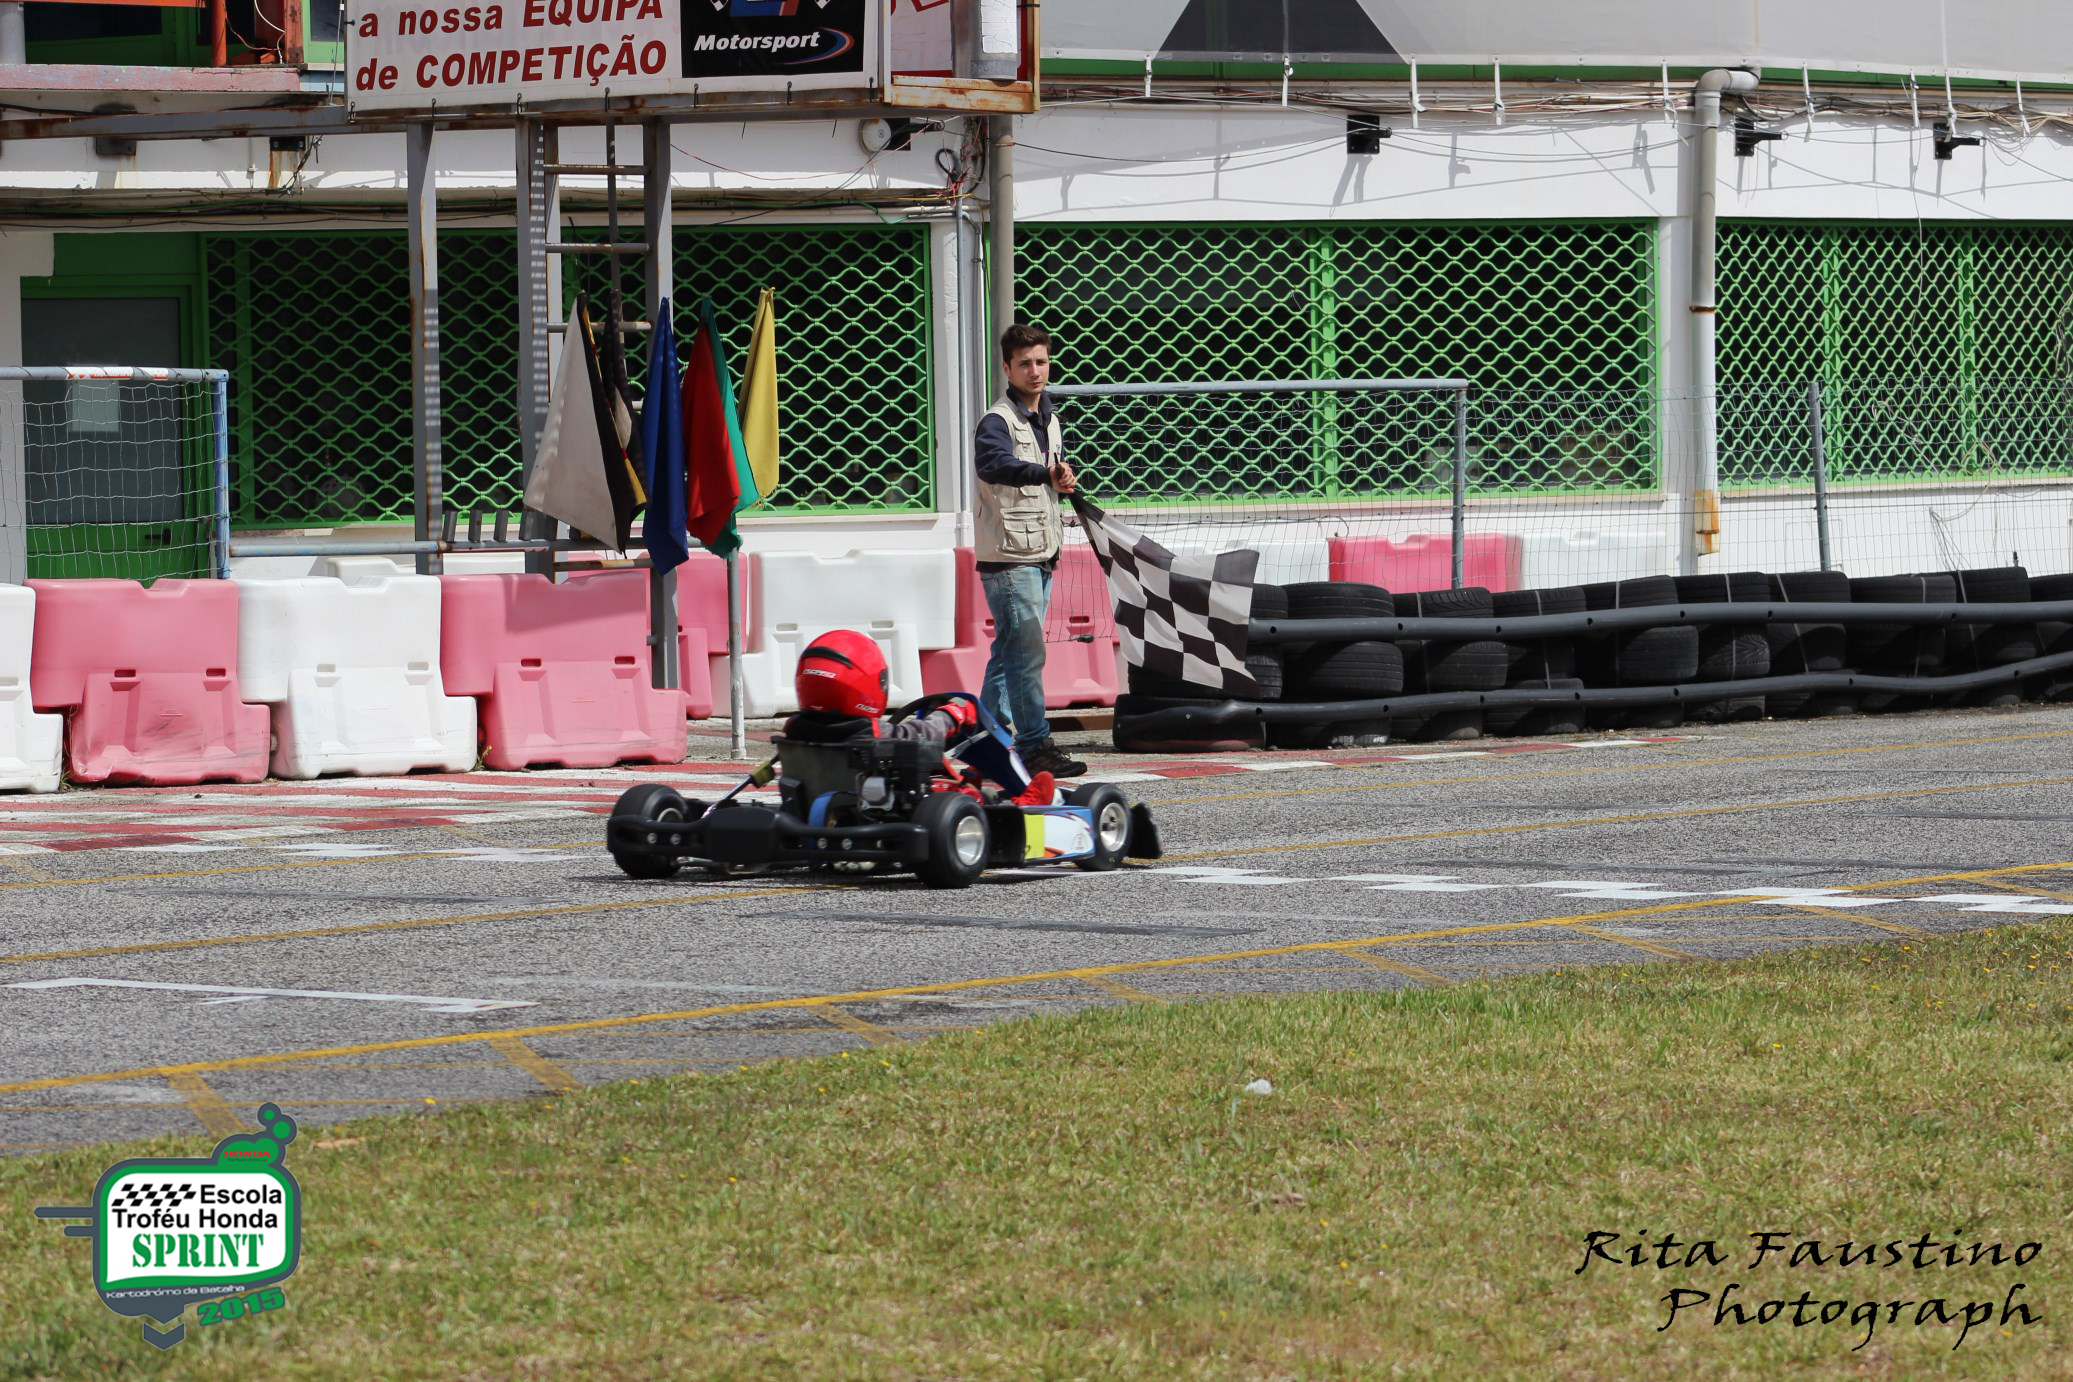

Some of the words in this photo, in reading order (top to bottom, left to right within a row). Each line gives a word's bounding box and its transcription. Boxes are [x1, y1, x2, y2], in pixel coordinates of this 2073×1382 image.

[358, 12, 379, 38] a
[398, 5, 503, 36] nossa
[522, 0, 663, 28] EQUIPA
[693, 31, 821, 53] Motorsport
[355, 58, 399, 91] de
[416, 34, 668, 88] COMPETIÇÃO
